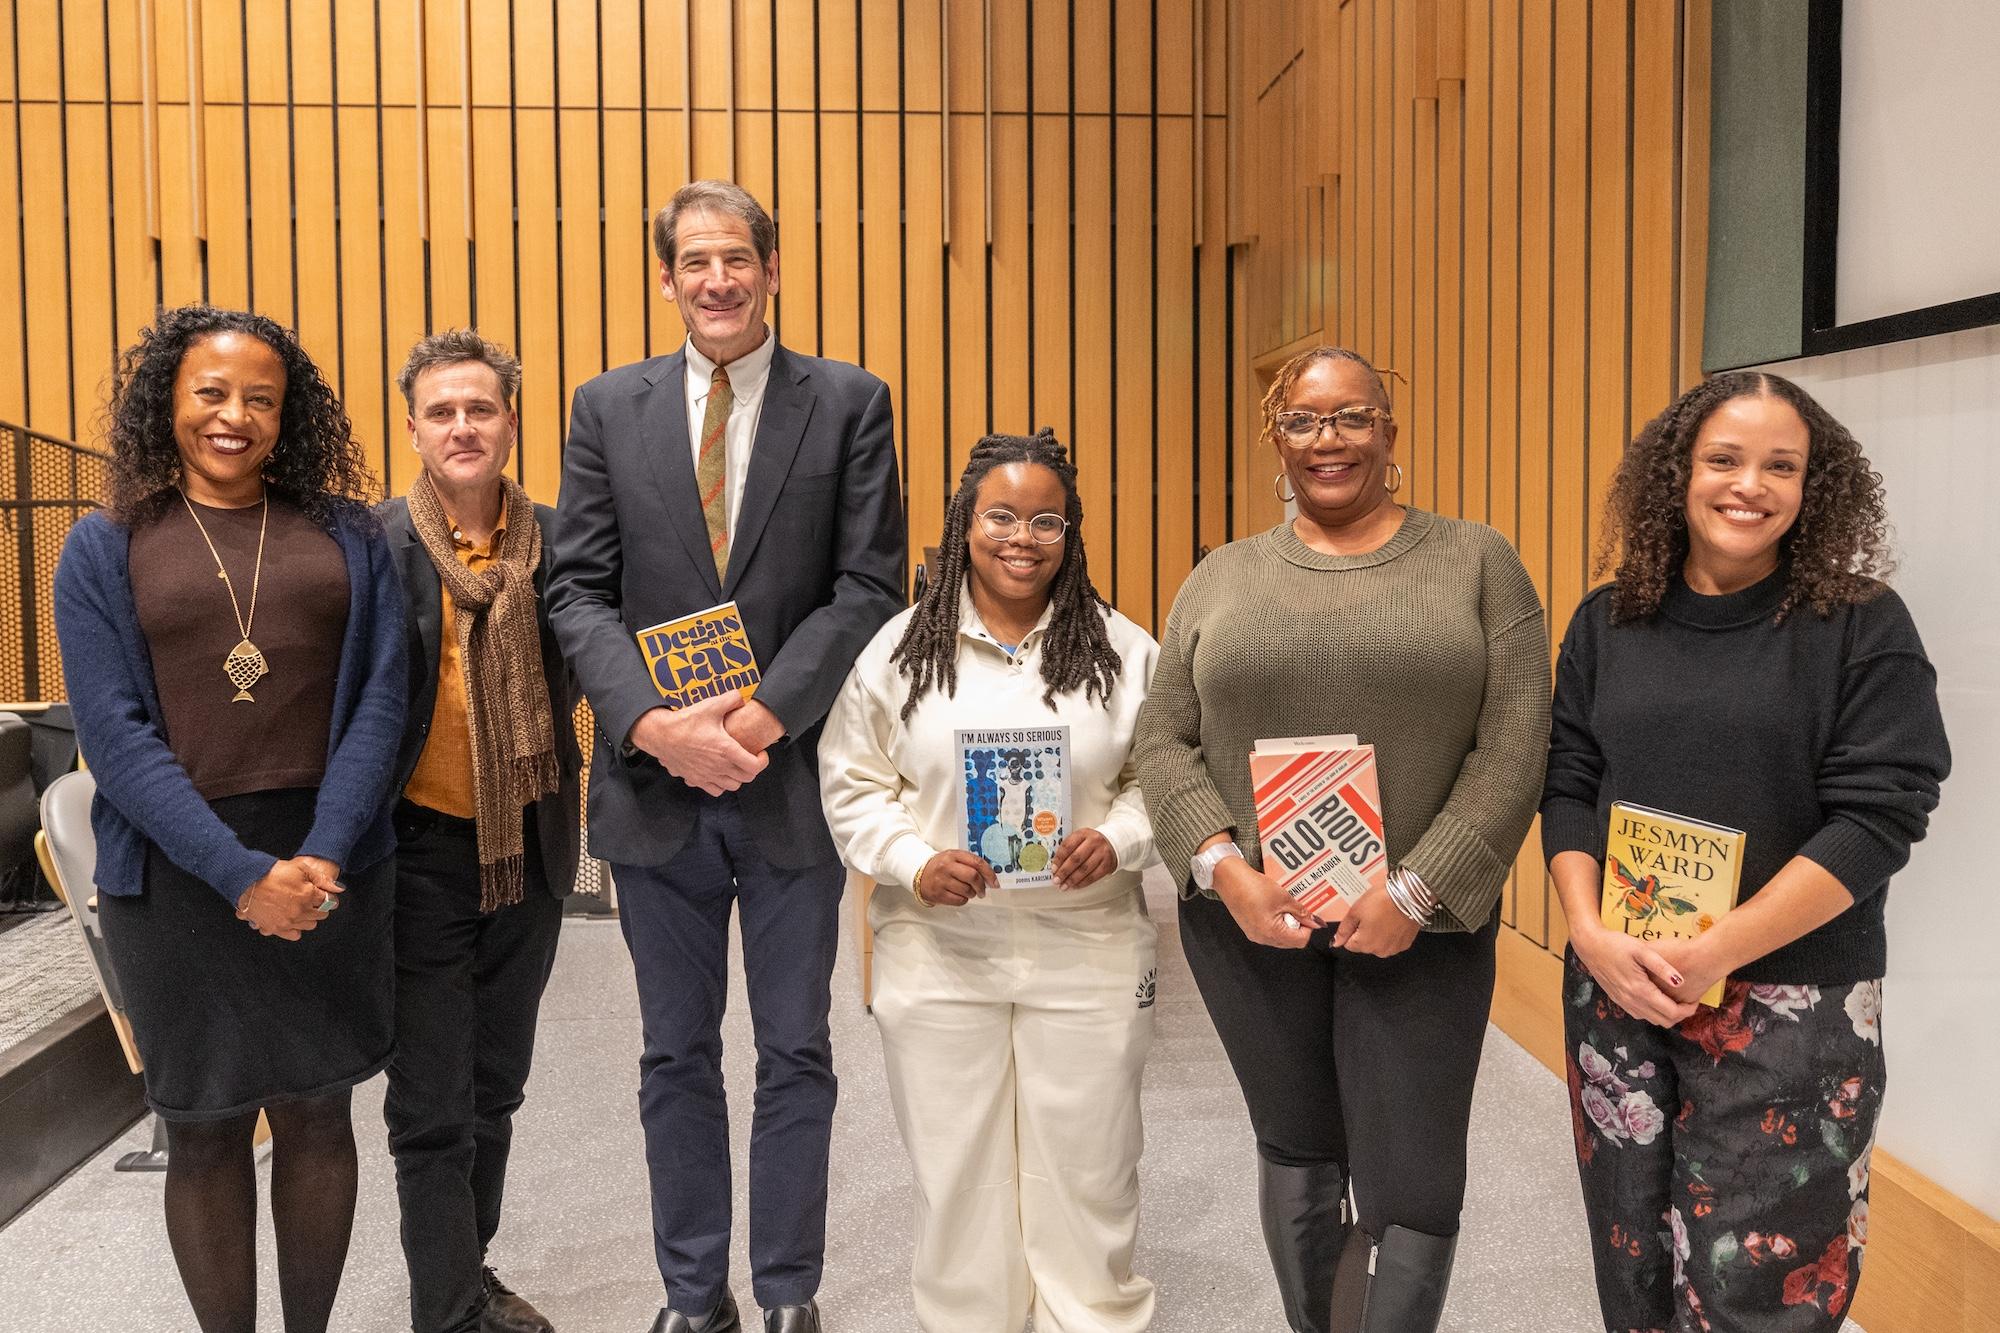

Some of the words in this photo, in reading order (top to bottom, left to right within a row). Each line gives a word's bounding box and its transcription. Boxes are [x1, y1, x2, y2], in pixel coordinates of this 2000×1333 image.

[644, 615, 741, 659] Degas
[654, 638, 752, 692] Gas
[664, 668, 760, 711] Station
[961, 733, 975, 744] I'M
[977, 732, 1010, 744] ALWAYS
[1012, 732, 1024, 743] SO
[1026, 730, 1062, 742] SERIOUS
[1269, 819, 1325, 871] GLO
[1308, 794, 1381, 866] RIOUS
[1617, 818, 1729, 862] JESMYN
[1287, 879, 1308, 898] RNICE
[1310, 854, 1342, 881] McFADDEN
[1628, 844, 1715, 882] WARD
[1623, 915, 1662, 941] Let
